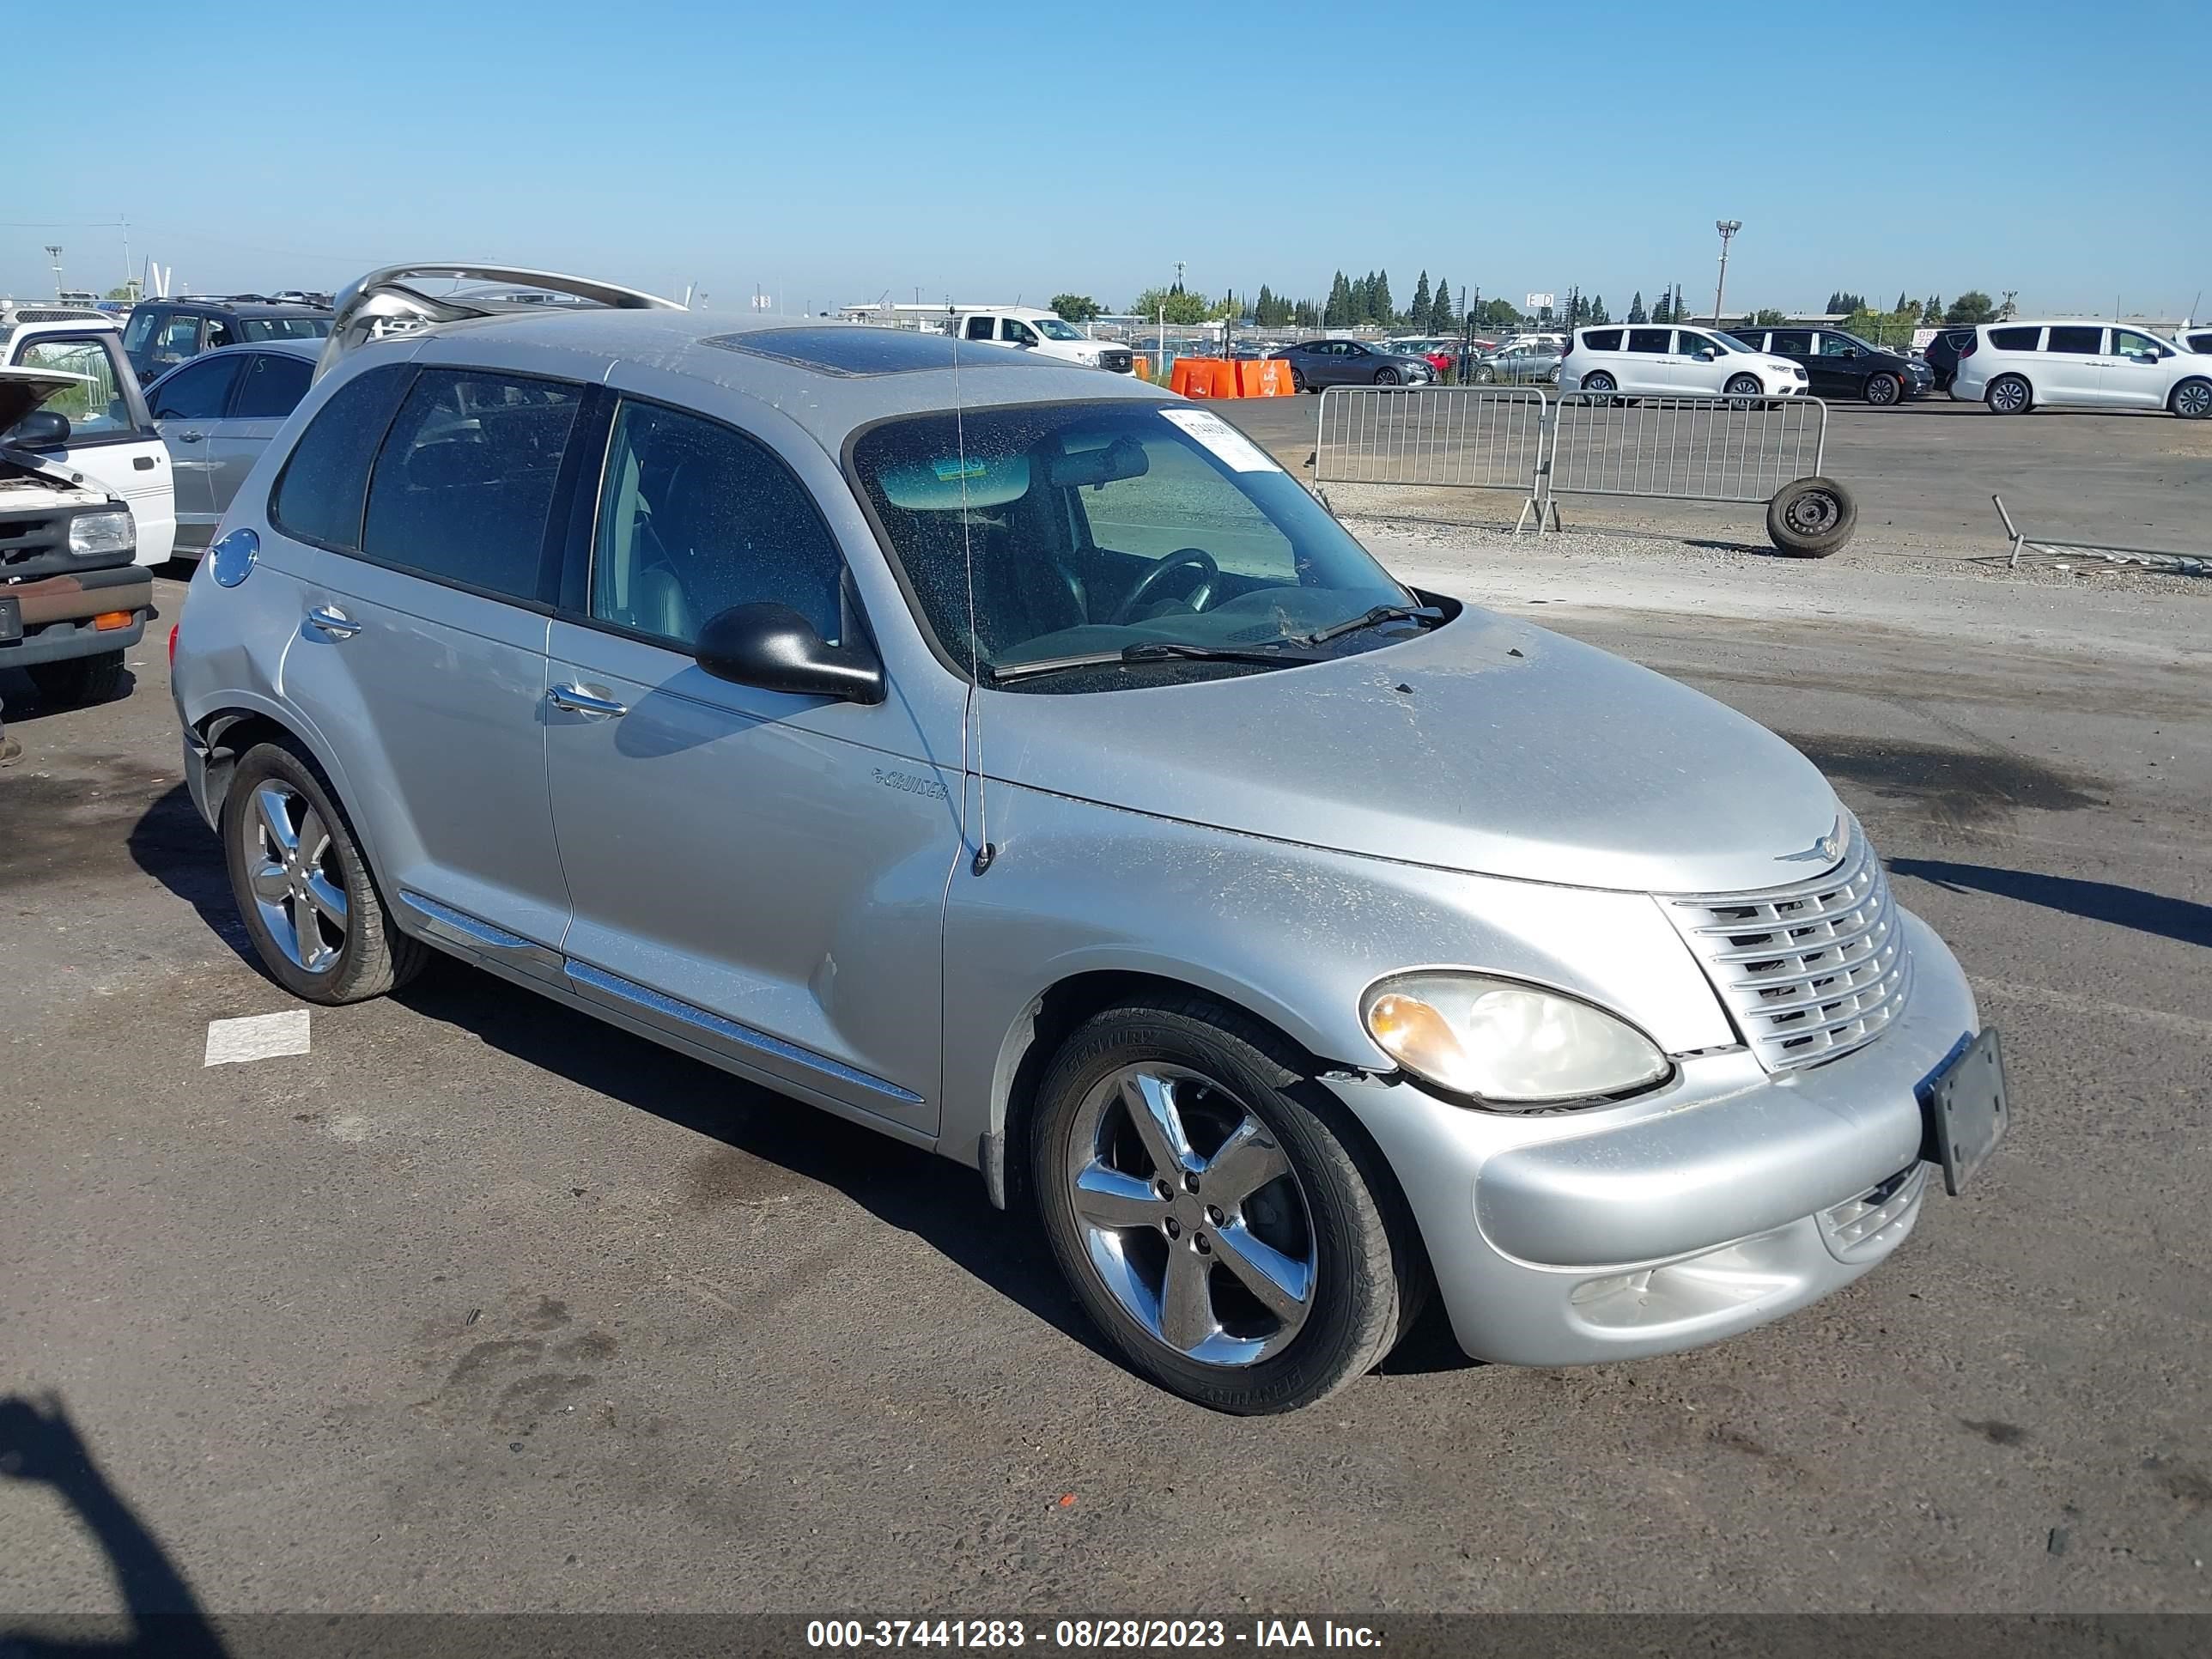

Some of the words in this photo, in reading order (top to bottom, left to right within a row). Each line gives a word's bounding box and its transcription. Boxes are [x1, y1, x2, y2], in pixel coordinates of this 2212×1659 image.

[1529, 294, 1536, 307] E
[1543, 295, 1552, 307] D
[884, 771, 949, 800] CRUISER
[1066, 1030, 1158, 1074] CENTURY
